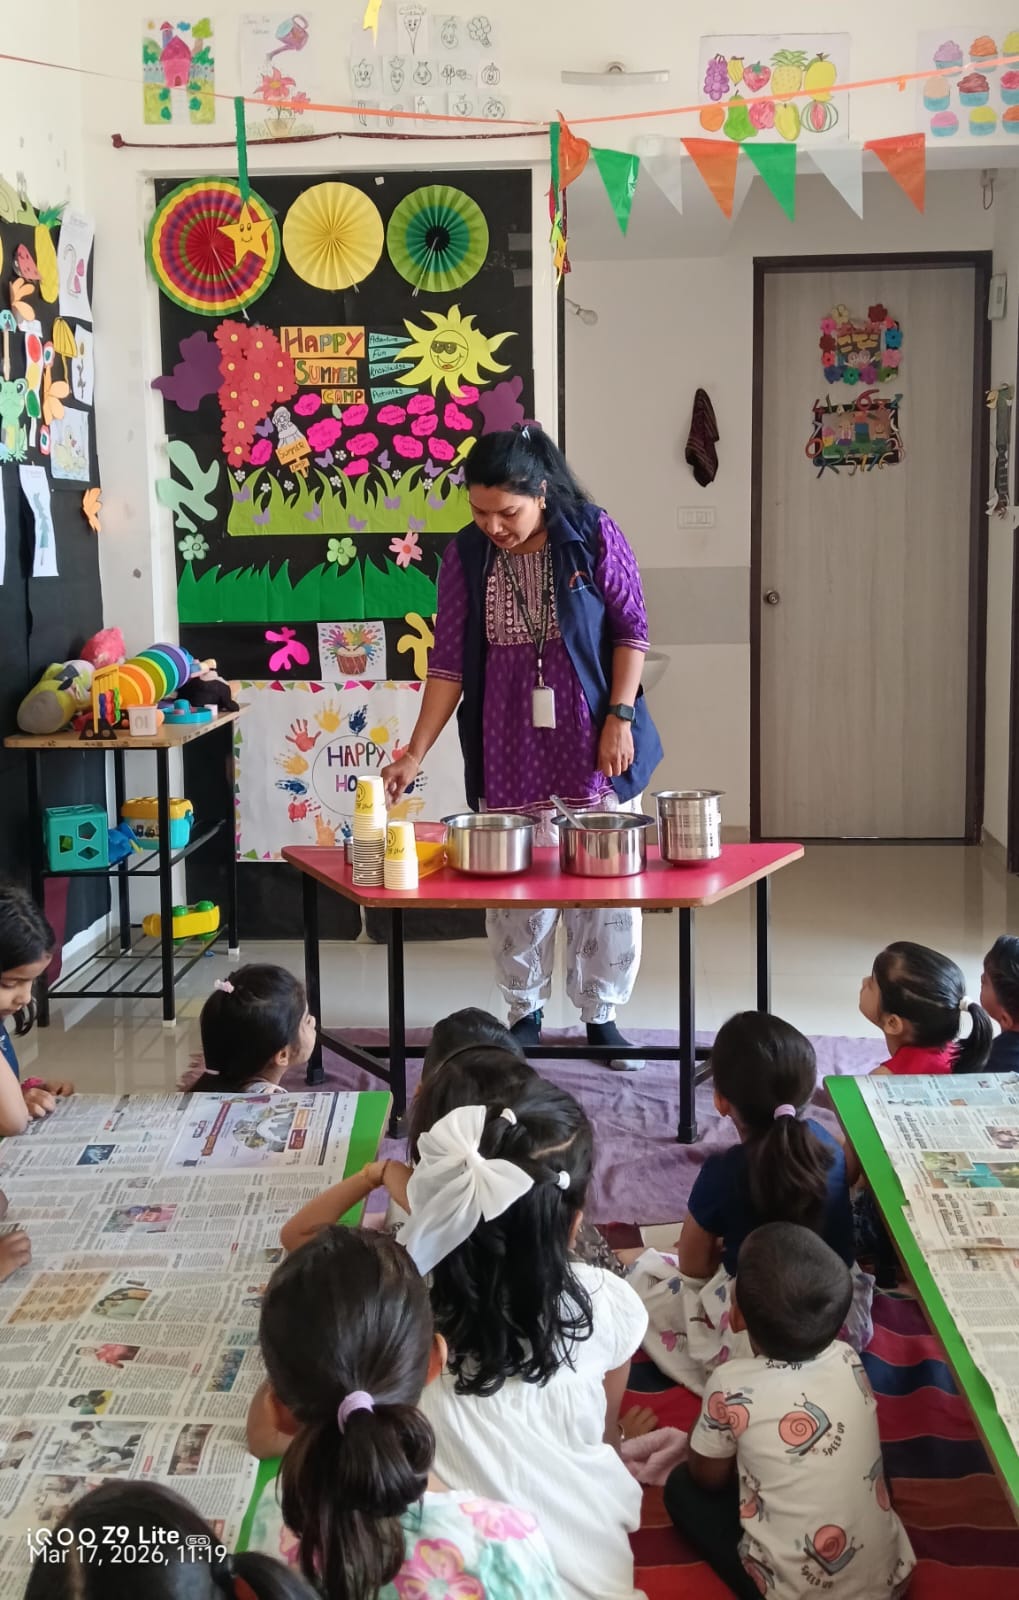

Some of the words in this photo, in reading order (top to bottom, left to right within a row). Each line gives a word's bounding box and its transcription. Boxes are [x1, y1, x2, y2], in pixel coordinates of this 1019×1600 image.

[296, 360, 358, 385] SUMMER
[322, 389, 364, 404] CAMP
[327, 741, 386, 768] HAPPY
[335, 774, 358, 793] HO
[822, 1434, 842, 1457] SPEED
[837, 1421, 845, 1434] UP
